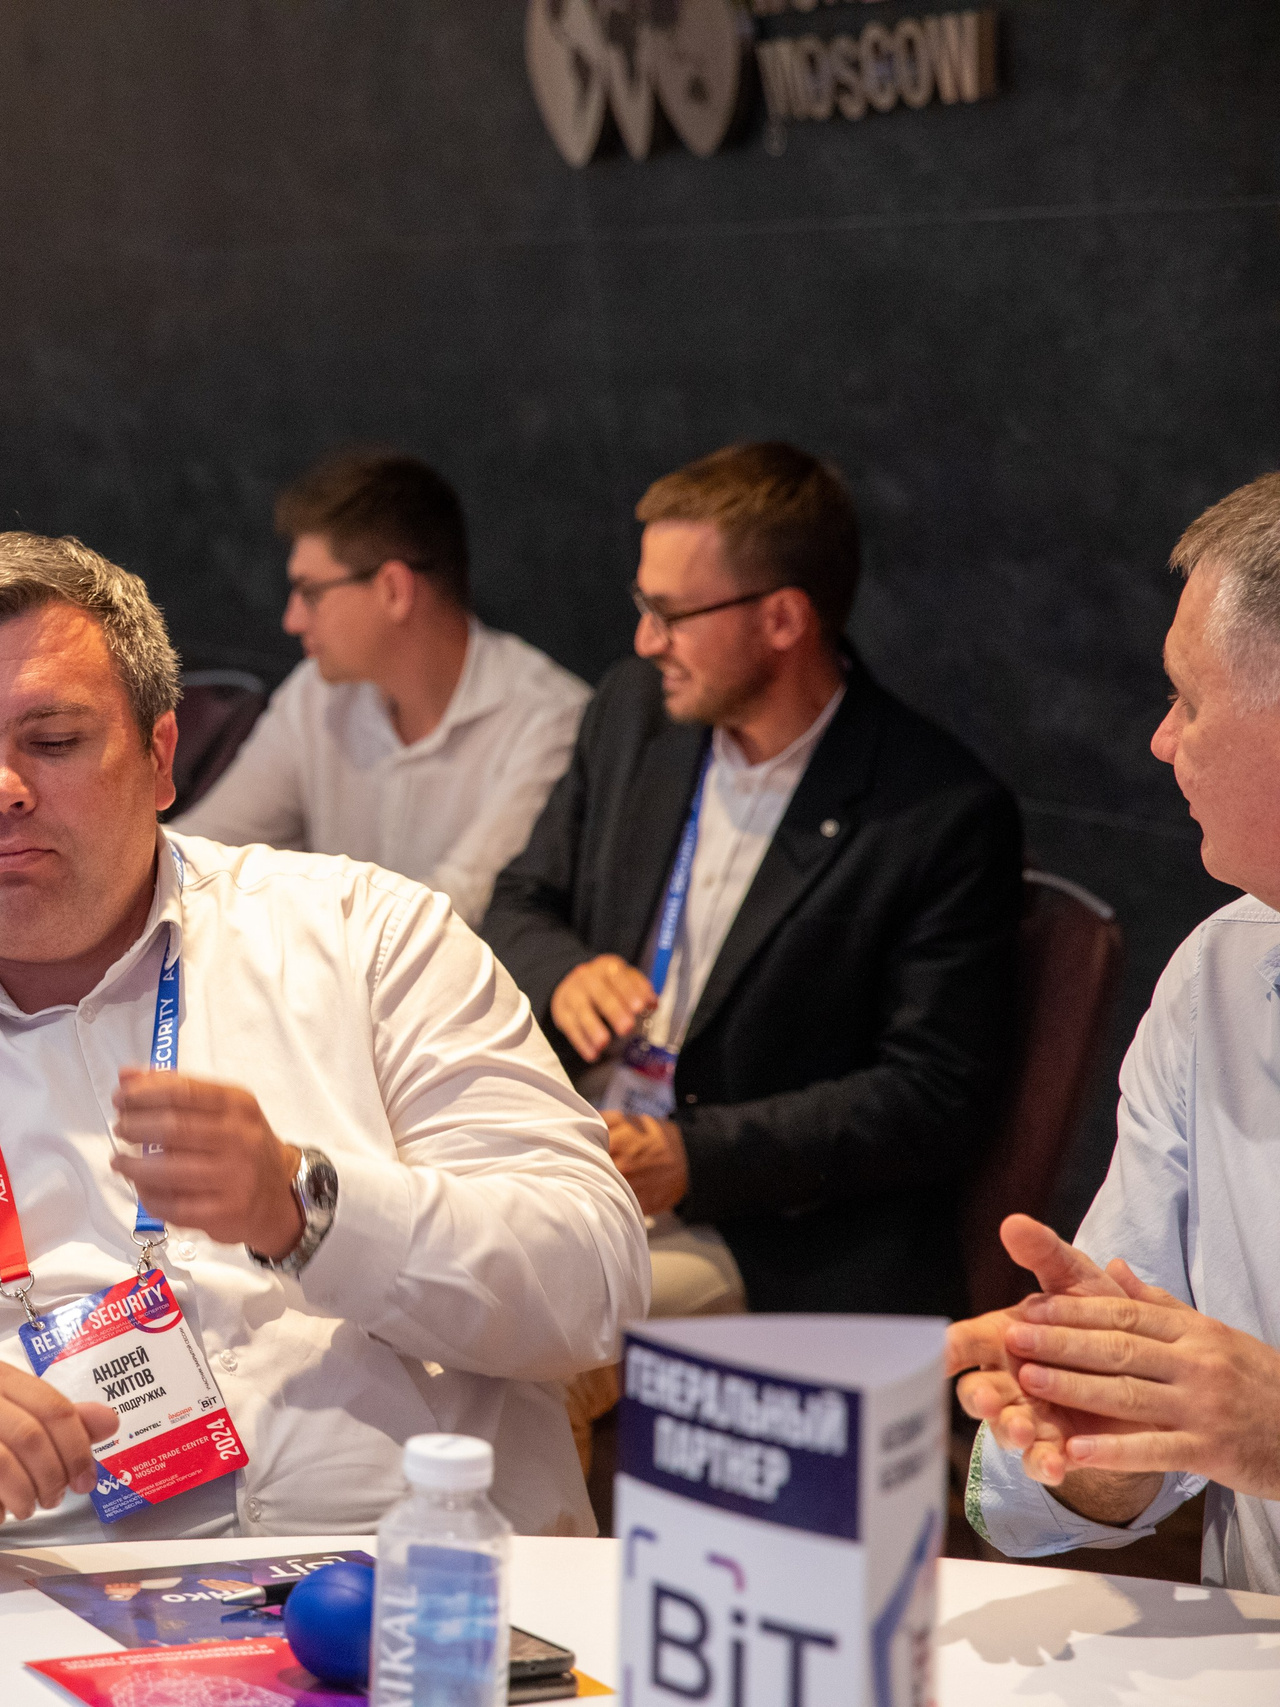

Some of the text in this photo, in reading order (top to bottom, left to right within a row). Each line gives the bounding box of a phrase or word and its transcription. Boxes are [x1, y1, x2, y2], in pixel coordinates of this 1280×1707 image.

[756, 12, 982, 121] MOSCOW
[155, 997, 174, 1073] ECURITY
[31, 1284, 164, 1355] RETAIL SECURITY
[92, 1346, 149, 1384] АНДРЕЙ
[102, 1368, 155, 1402] ЖИТОВ
[119, 1386, 166, 1414] ПОДРУЖКА
[626, 1343, 849, 1457] ГЕНЕРАЛЬНЫЙ
[131, 1435, 209, 1473] WORLD TRADE CENTER
[206, 1417, 241, 1461] 2024
[652, 1414, 791, 1503] ПАРТНЕР
[135, 1462, 166, 1479] MOSCOW
